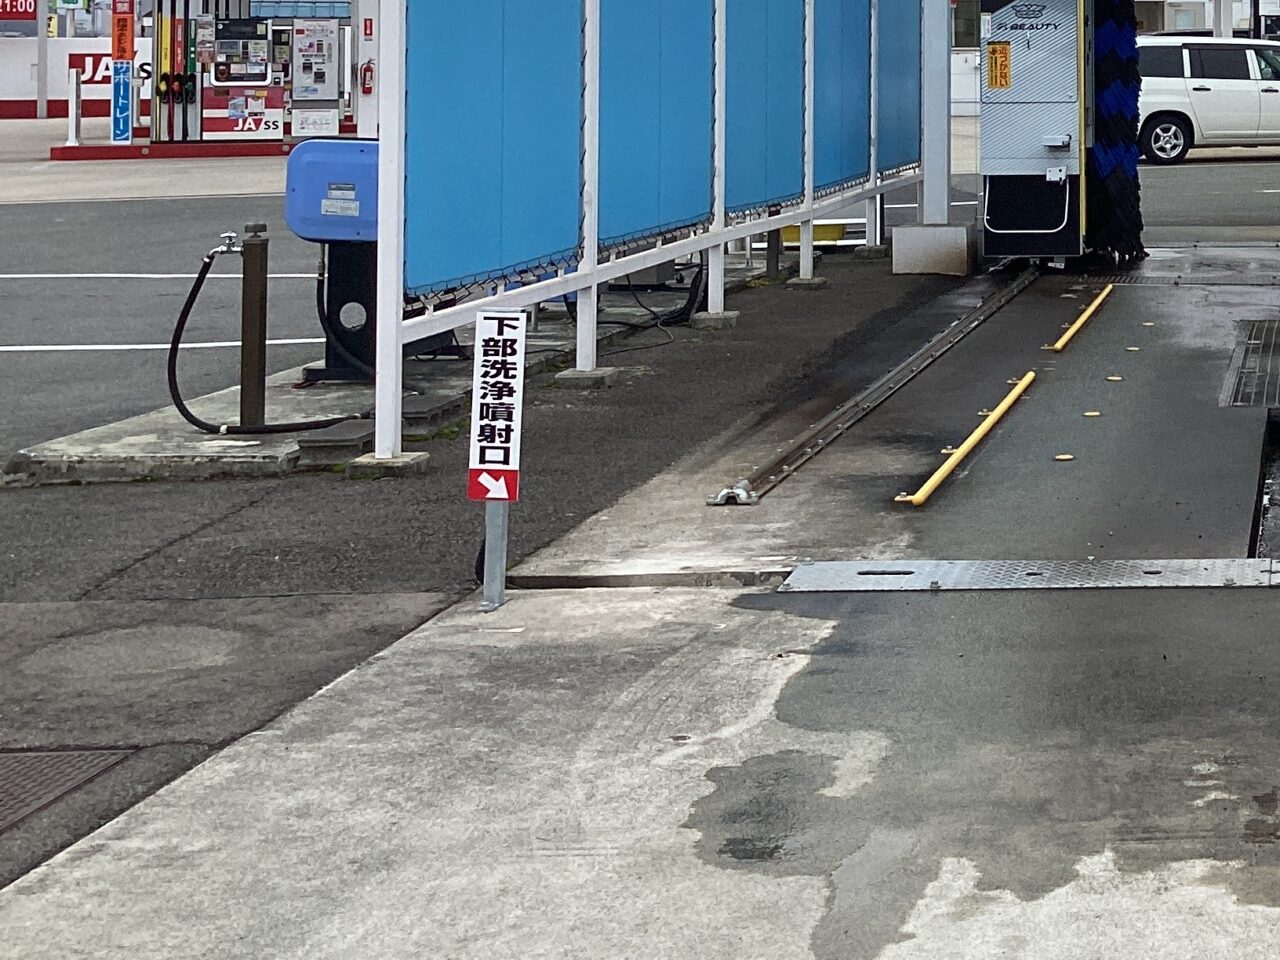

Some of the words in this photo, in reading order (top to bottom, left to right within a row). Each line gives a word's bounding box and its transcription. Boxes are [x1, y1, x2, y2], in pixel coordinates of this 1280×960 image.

[114, 62, 130, 139] サポートレーン
[477, 316, 520, 466] 下部洗浄噴射口
